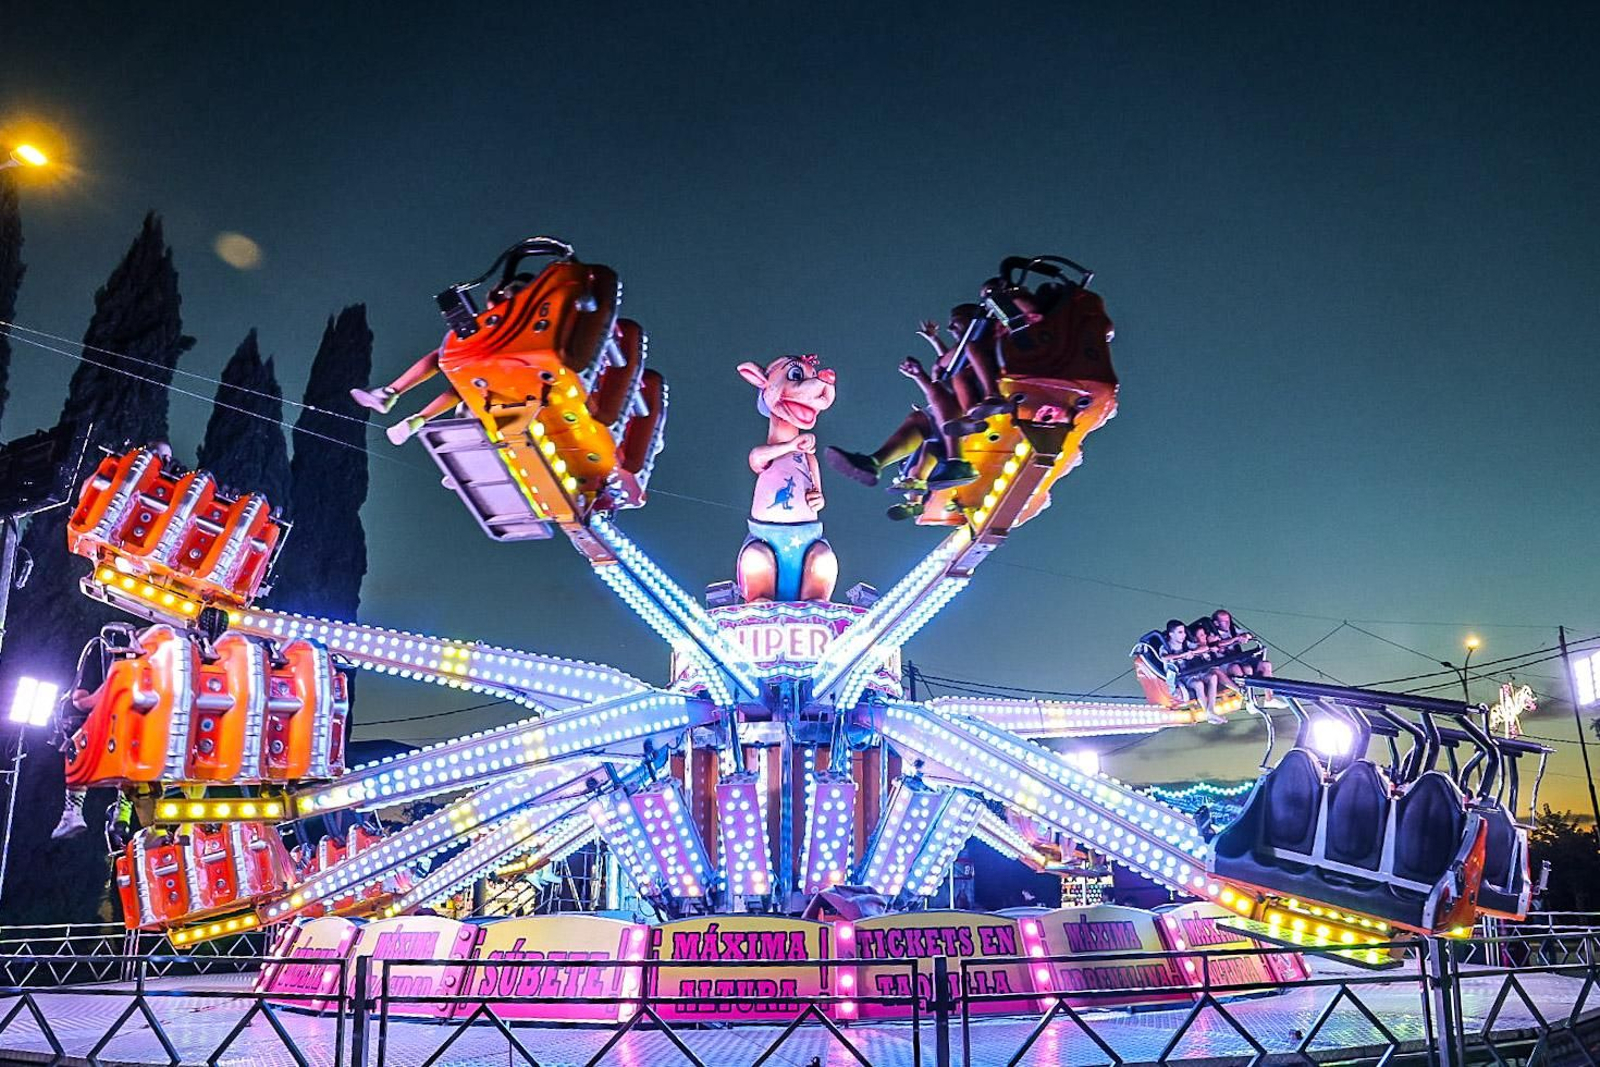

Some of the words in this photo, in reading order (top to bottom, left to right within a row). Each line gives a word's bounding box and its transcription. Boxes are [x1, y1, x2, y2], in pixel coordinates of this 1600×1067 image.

[856, 927, 974, 958] TICKETS
[977, 925, 1018, 956] EN
[1063, 913, 1143, 953] MÁXIMA
[875, 970, 1013, 1008] TAQILA
